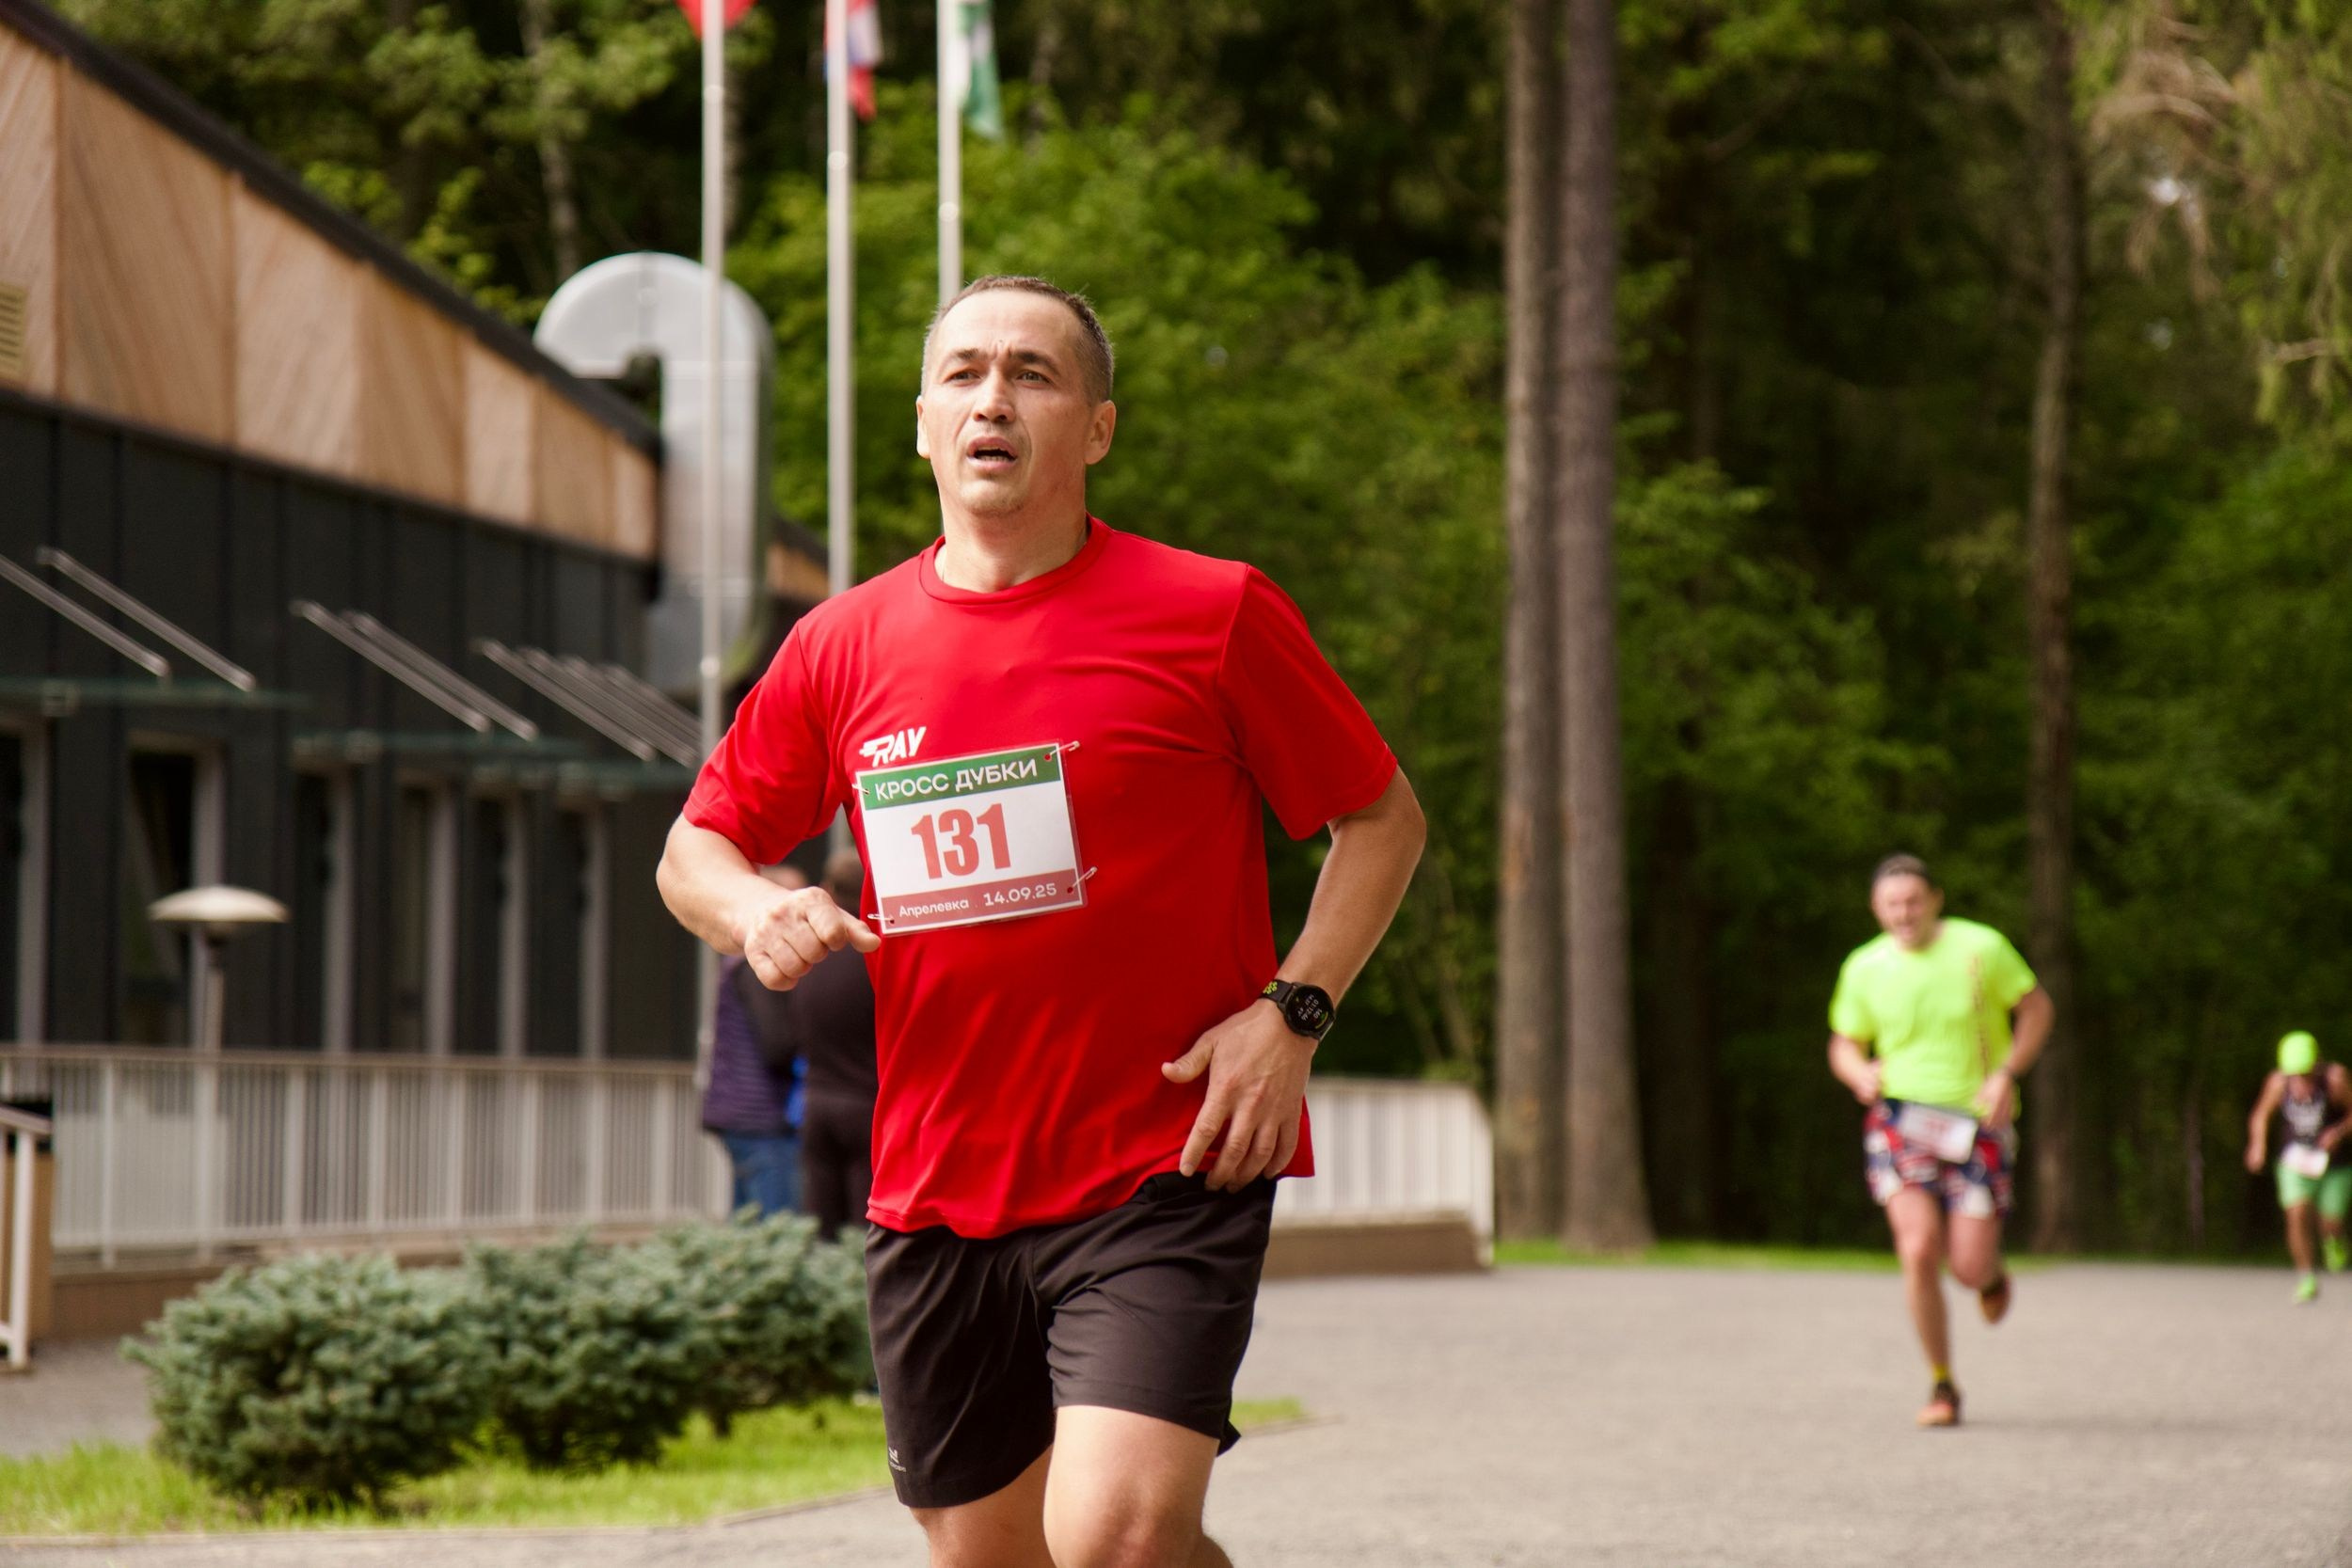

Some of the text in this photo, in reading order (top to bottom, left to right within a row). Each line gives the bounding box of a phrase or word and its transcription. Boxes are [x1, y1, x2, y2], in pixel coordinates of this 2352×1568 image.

[860, 726, 927, 768] RAY
[875, 759, 1038, 800] КРОСС ДУБКИ
[911, 802, 1011, 880] 131
[898, 883, 1057, 918] Апрелевка 14.09.25
